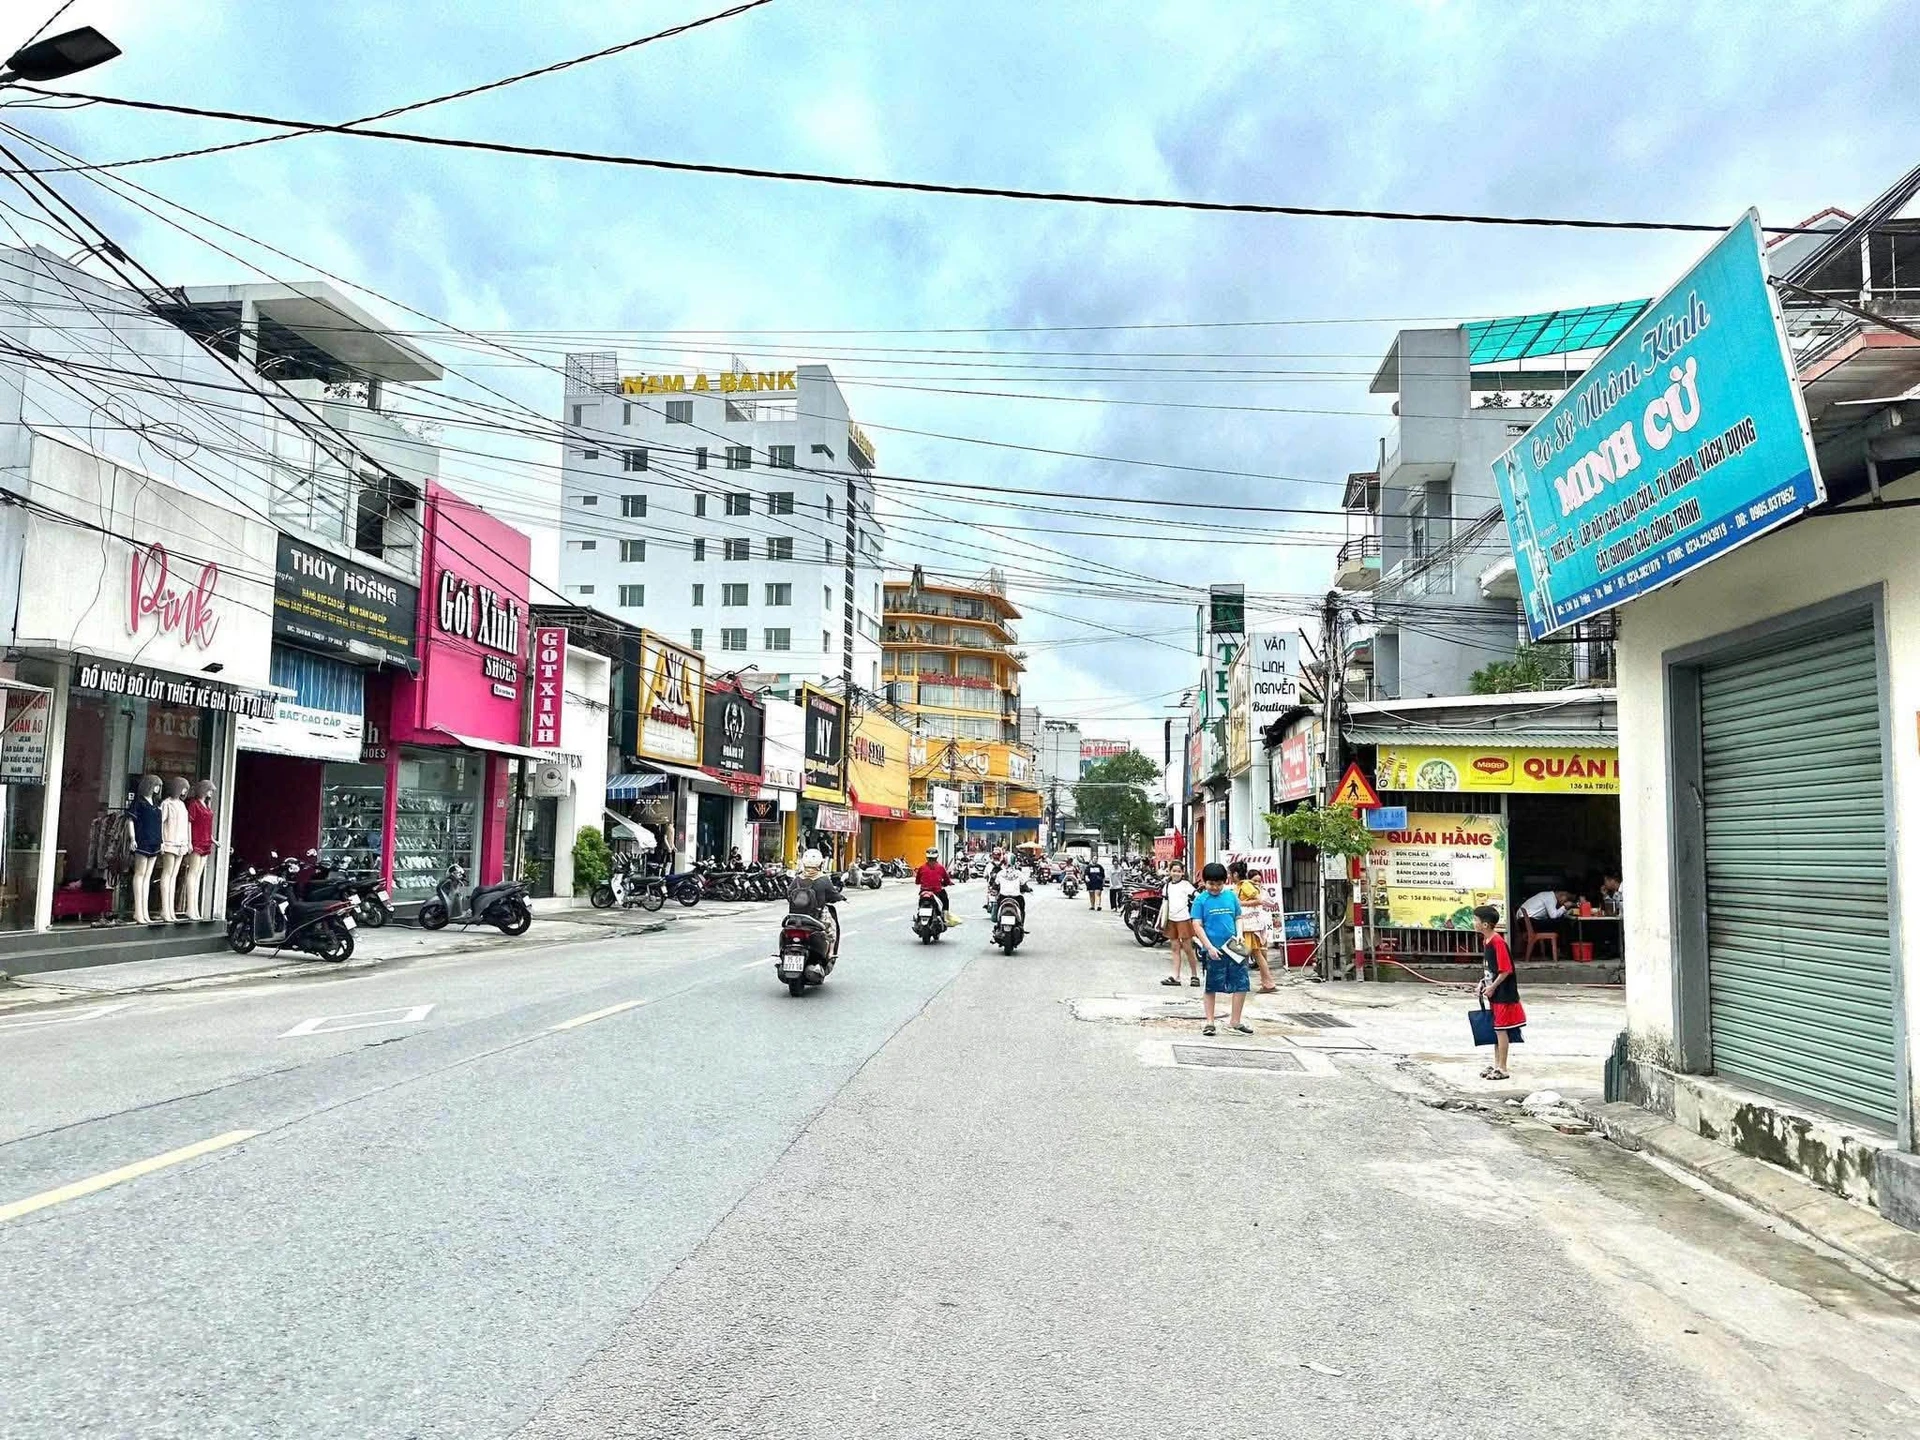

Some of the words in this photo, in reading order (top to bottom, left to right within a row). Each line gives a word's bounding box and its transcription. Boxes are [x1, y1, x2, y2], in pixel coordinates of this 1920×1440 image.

[1643, 291, 1710, 374] Kính
[623, 375, 686, 394] NAM
[720, 371, 796, 393] BANK
[1698, 438, 1725, 471] VÁCH
[1554, 421, 1641, 517] MINH
[485, 654, 517, 683] SHOES
[1262, 660, 1285, 673] LINH
[100, 668, 126, 693] NGỦ
[145, 676, 164, 699] LÓT
[167, 681, 195, 705] THIẾT
[210, 690, 226, 710] GIÁ
[1252, 702, 1292, 714] Boutiqu
[1477, 761, 1505, 769] Maggi
[1523, 755, 1607, 781] QUÁN
[1387, 828, 1436, 845] QUÁN
[1442, 826, 1493, 845] HẰNG
